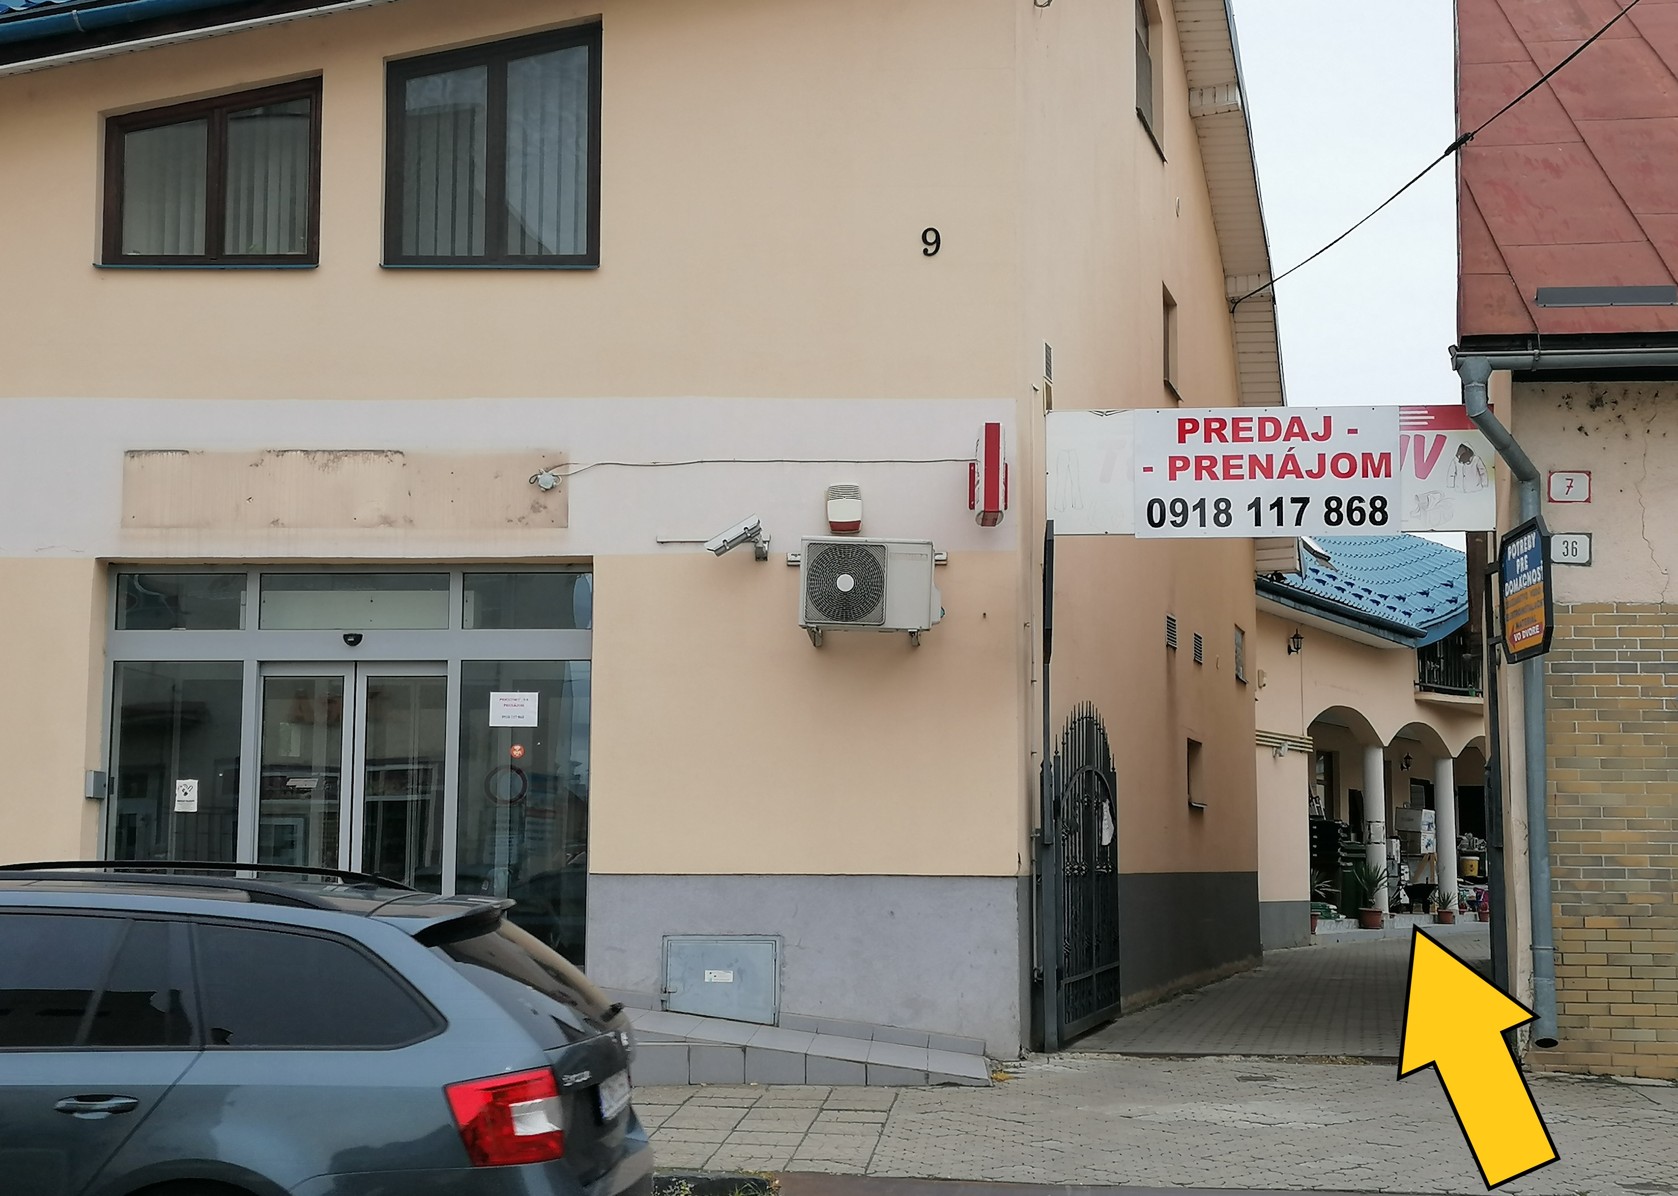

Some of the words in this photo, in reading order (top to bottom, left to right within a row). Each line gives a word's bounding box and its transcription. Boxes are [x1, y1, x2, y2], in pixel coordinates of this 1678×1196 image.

[921, 227, 941, 257] 9
[1177, 415, 1332, 444] PREDAJ
[1168, 446, 1392, 481] PRENÁJOM
[1565, 478, 1574, 496] 7
[1146, 497, 1233, 528] 0918
[1247, 496, 1311, 527] 117
[1323, 495, 1389, 526] 868
[1507, 531, 1536, 561] POTREBY
[1562, 540, 1578, 557] 36
[1516, 554, 1529, 575] PRE
